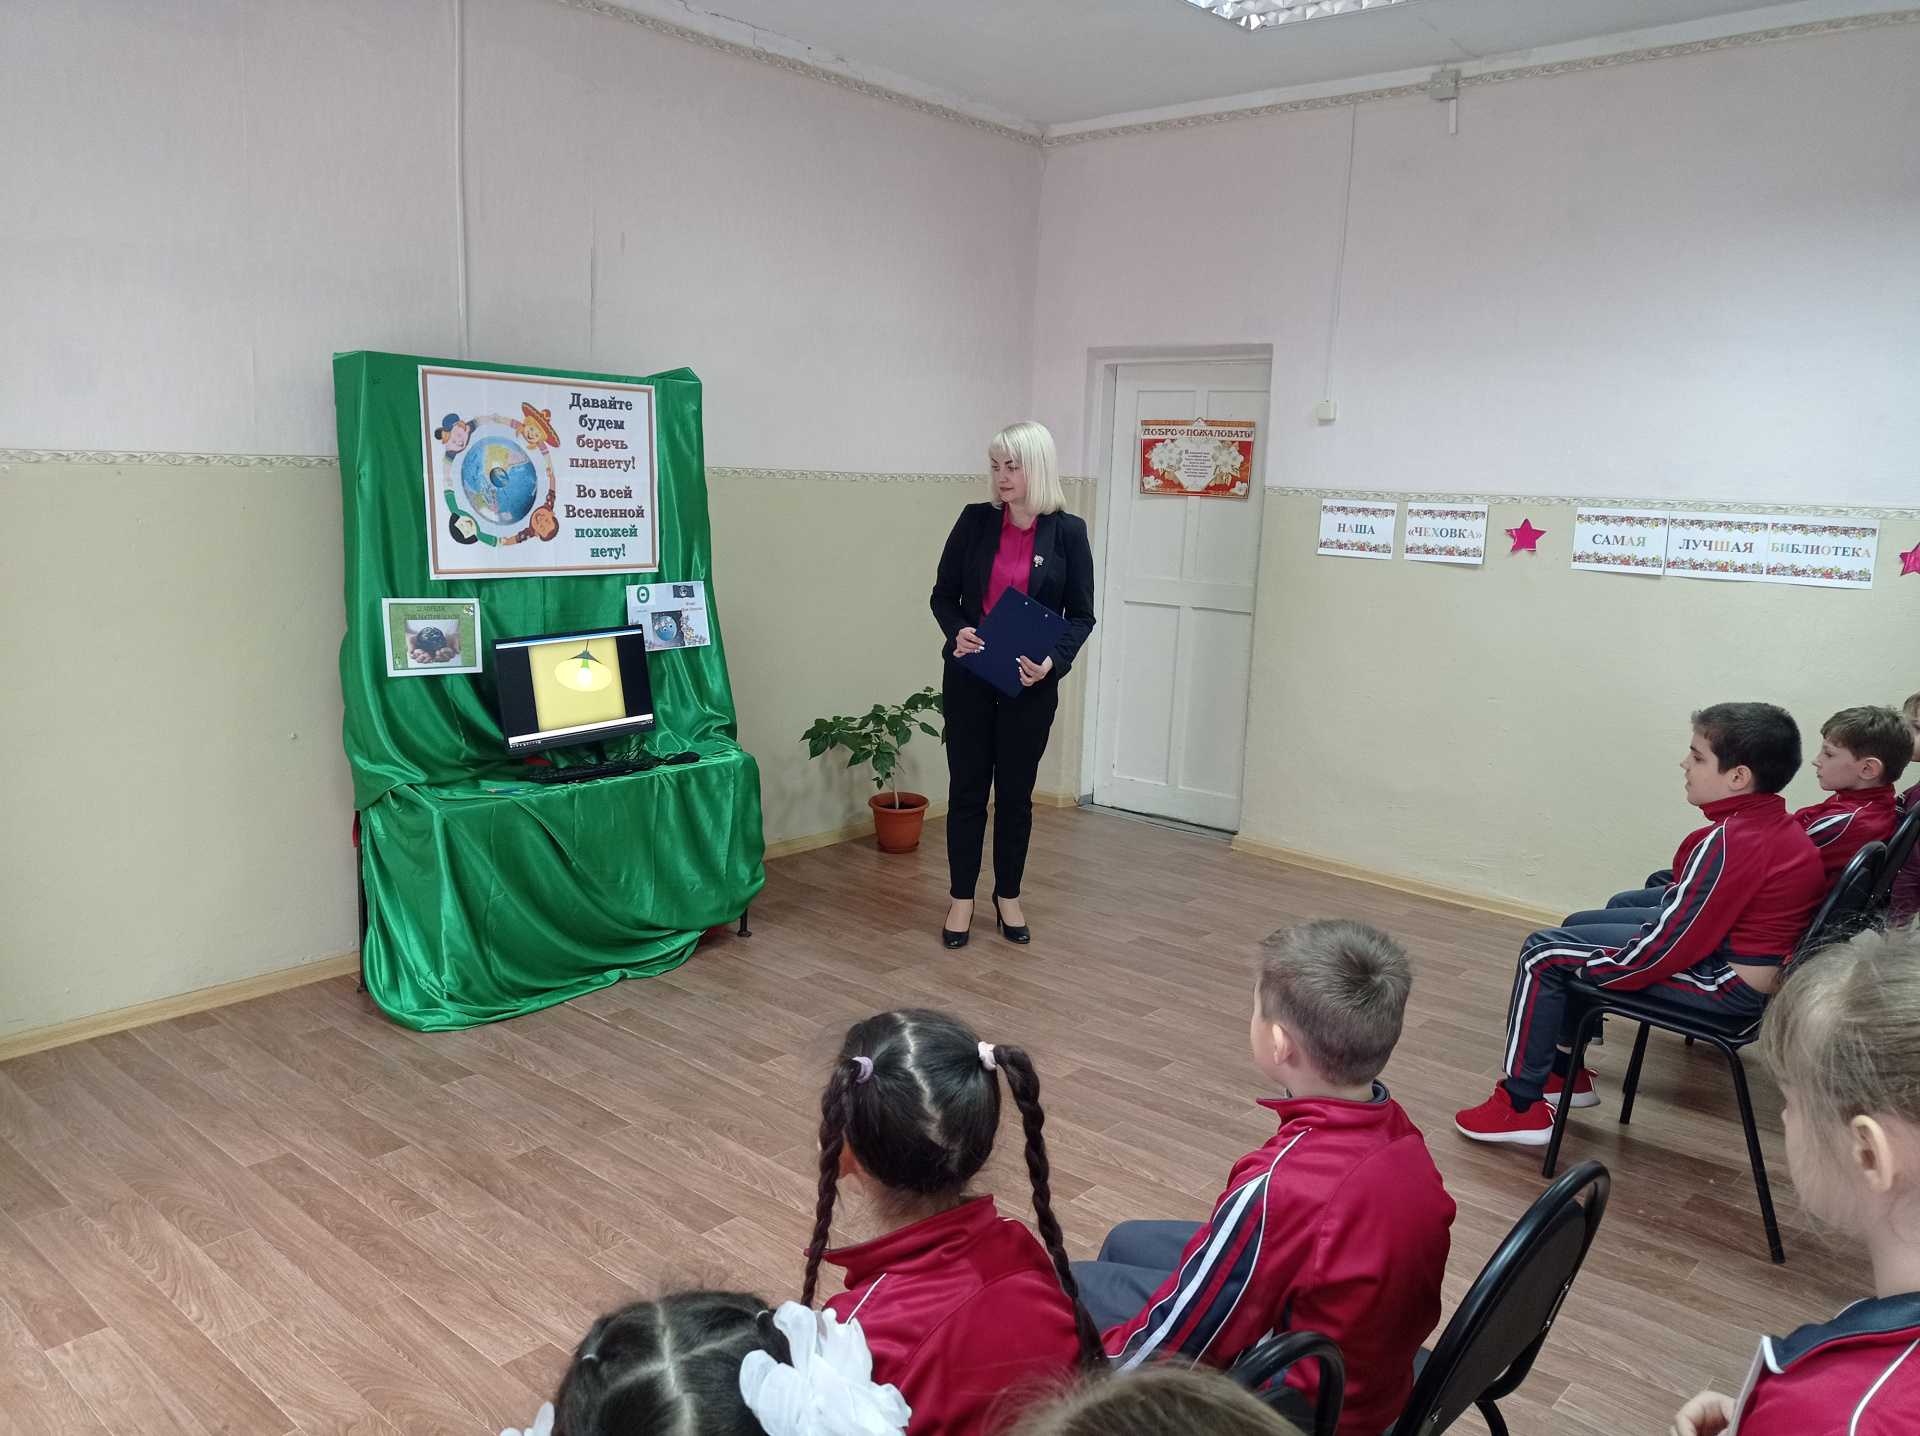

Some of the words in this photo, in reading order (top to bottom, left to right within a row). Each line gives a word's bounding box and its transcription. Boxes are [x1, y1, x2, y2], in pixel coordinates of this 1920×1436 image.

[569, 392, 633, 411] Давайте
[578, 414, 625, 431] будем
[1142, 428, 1177, 437] ДОБРО
[1186, 428, 1253, 439] ПОЖАЛОВАТЬ!
[576, 434, 628, 452] беречь
[569, 456, 636, 472] планету!
[576, 484, 596, 499] Во
[600, 485, 633, 499] всей
[564, 504, 645, 519] Вселенной
[575, 524, 638, 539] похожей
[1337, 522, 1376, 536] НАША
[1407, 525, 1483, 540] «ЧЕХОВКА»
[590, 543, 627, 560] нету!
[1591, 533, 1647, 549] САМАЯ
[1678, 538, 1754, 555] ЛУЧШАЯ
[1770, 542, 1872, 559] БИБЛИОТЕКА
